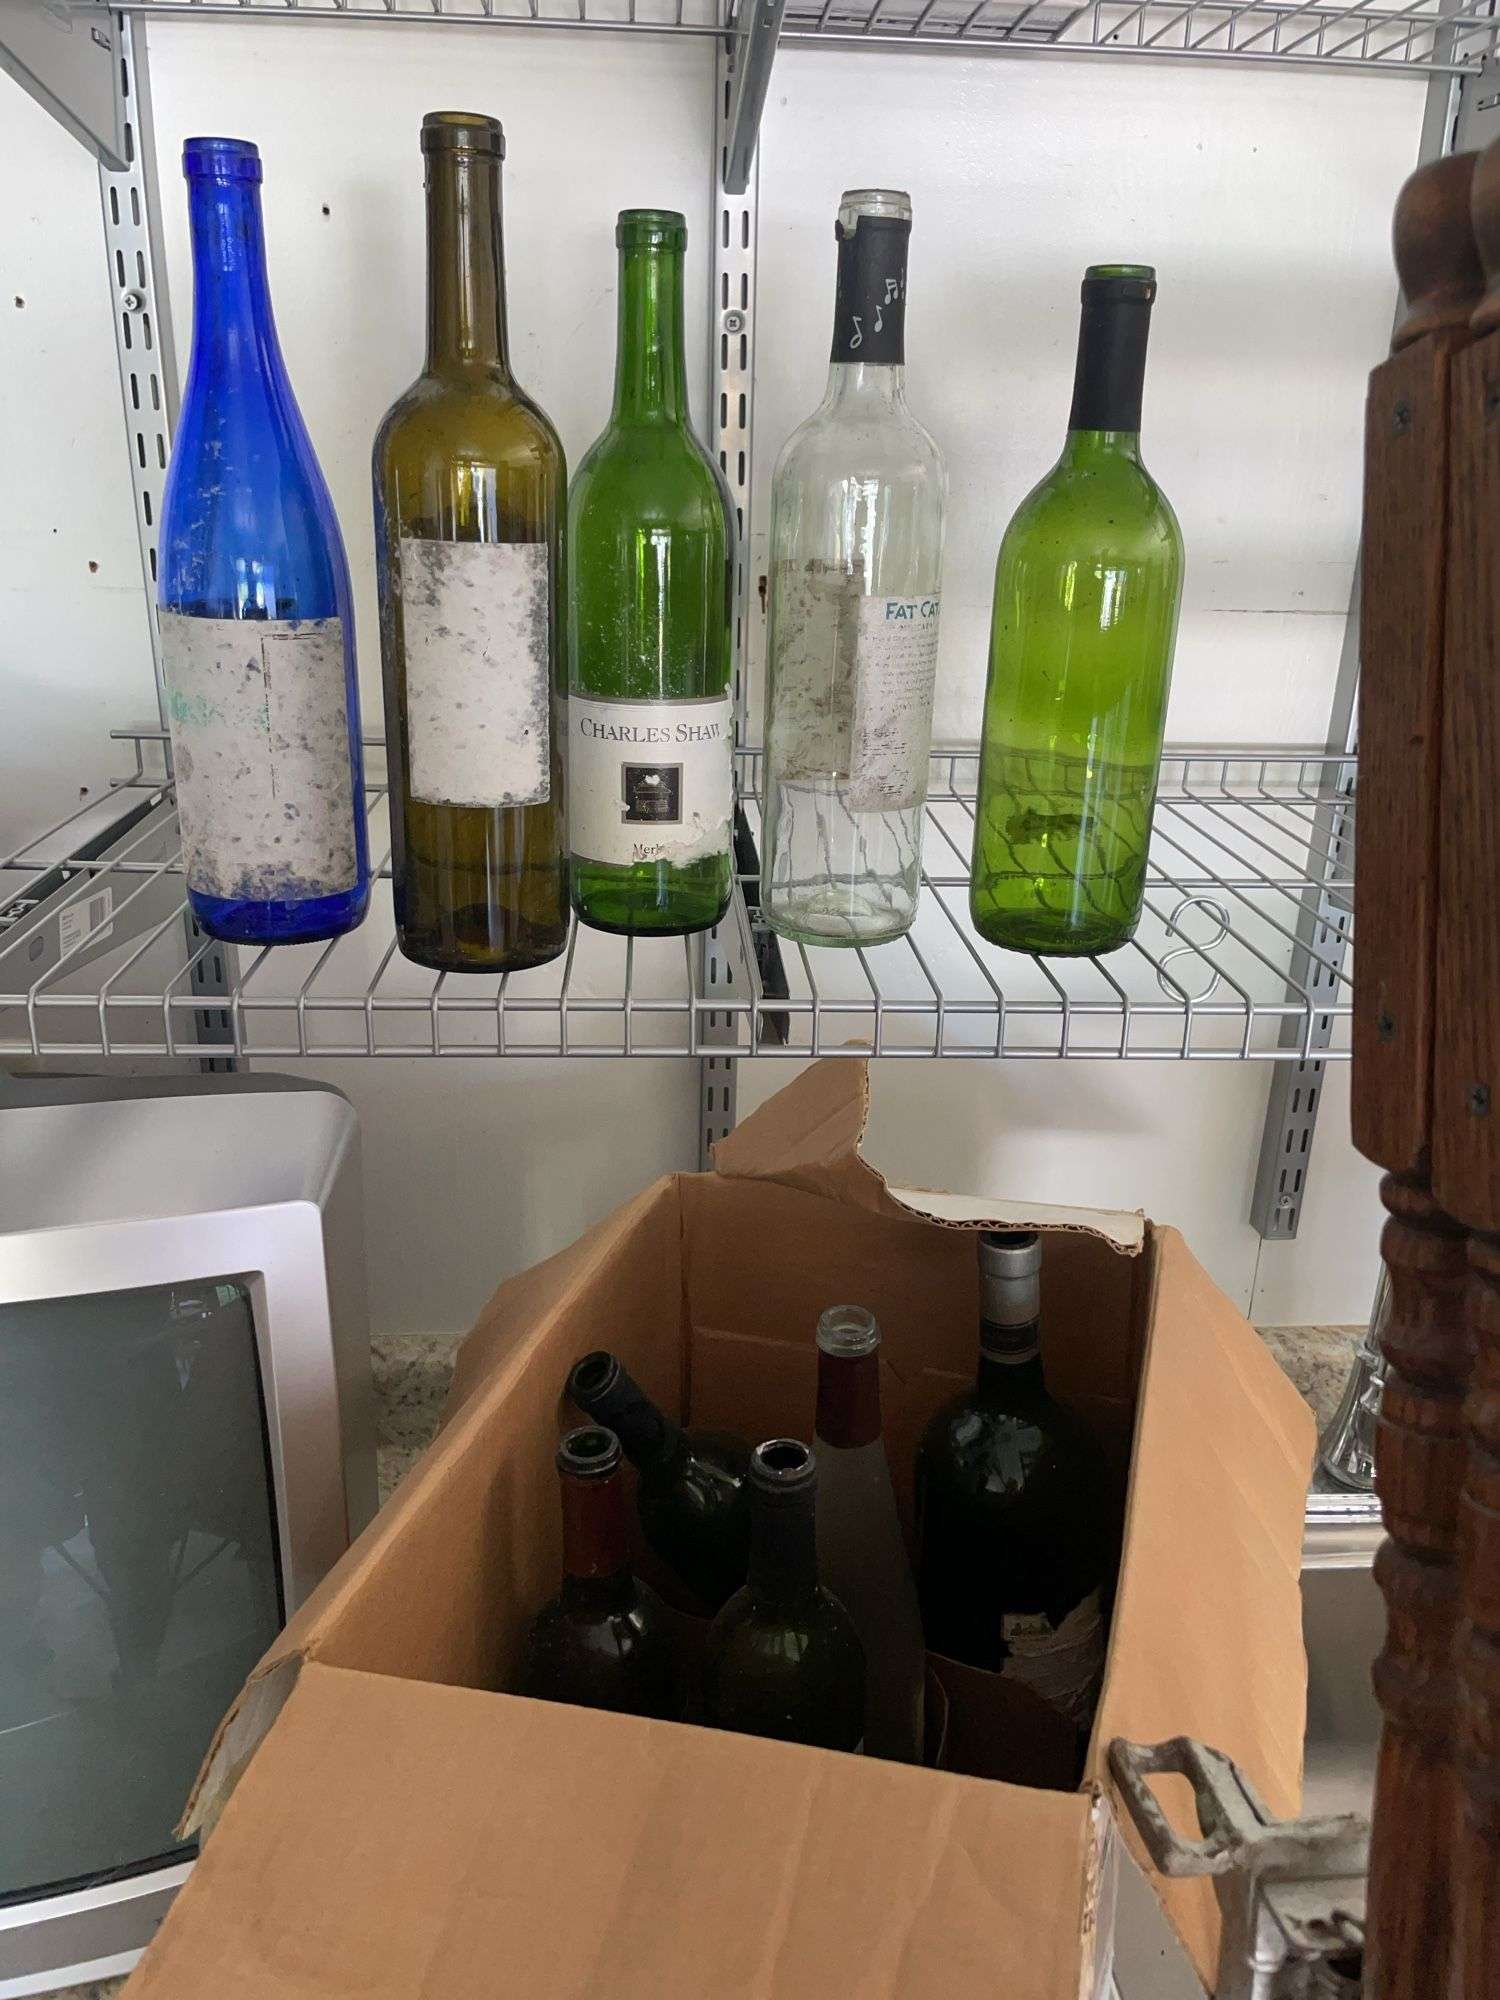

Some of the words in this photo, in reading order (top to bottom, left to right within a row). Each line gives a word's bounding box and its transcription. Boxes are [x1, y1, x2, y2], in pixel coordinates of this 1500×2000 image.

[885, 602, 918, 620] FAT
[920, 600, 940, 618] CAT
[580, 717, 670, 743] CHARLES
[675, 723, 720, 743] SHAW
